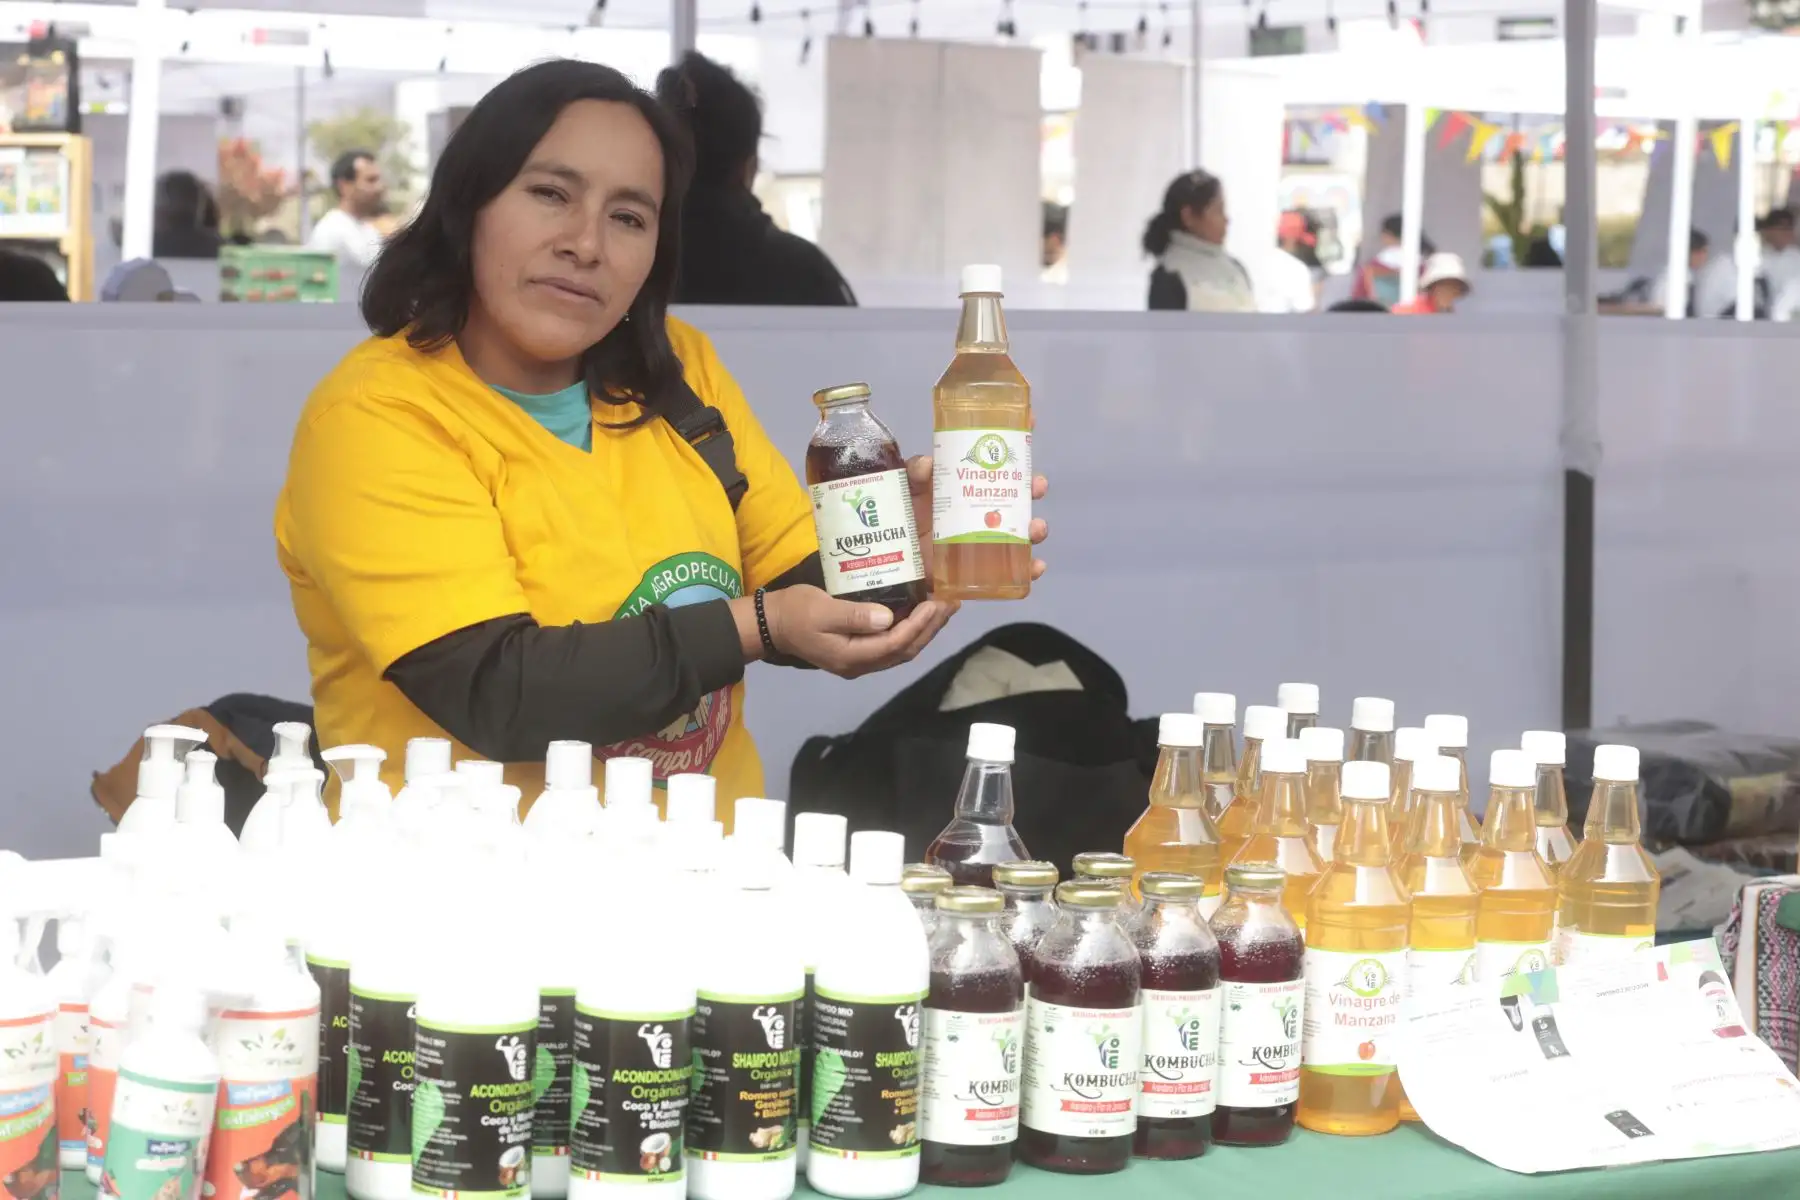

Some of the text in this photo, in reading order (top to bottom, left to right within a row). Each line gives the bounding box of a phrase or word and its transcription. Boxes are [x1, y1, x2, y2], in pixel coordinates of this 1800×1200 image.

[957, 467, 1023, 482] Vinagre de
[962, 484, 1018, 498] Manzana
[835, 526, 907, 552] KOMBUCHA
[1328, 992, 1401, 1010] Vinagre de
[1334, 1013, 1397, 1028] Manzana
[732, 1052, 779, 1068] SHAMPOO
[1144, 1051, 1216, 1069] KOMBUCHA
[1063, 1071, 1137, 1088] KOMBUCHA
[740, 1090, 778, 1100] Romero
[622, 1100, 651, 1111] Coco
